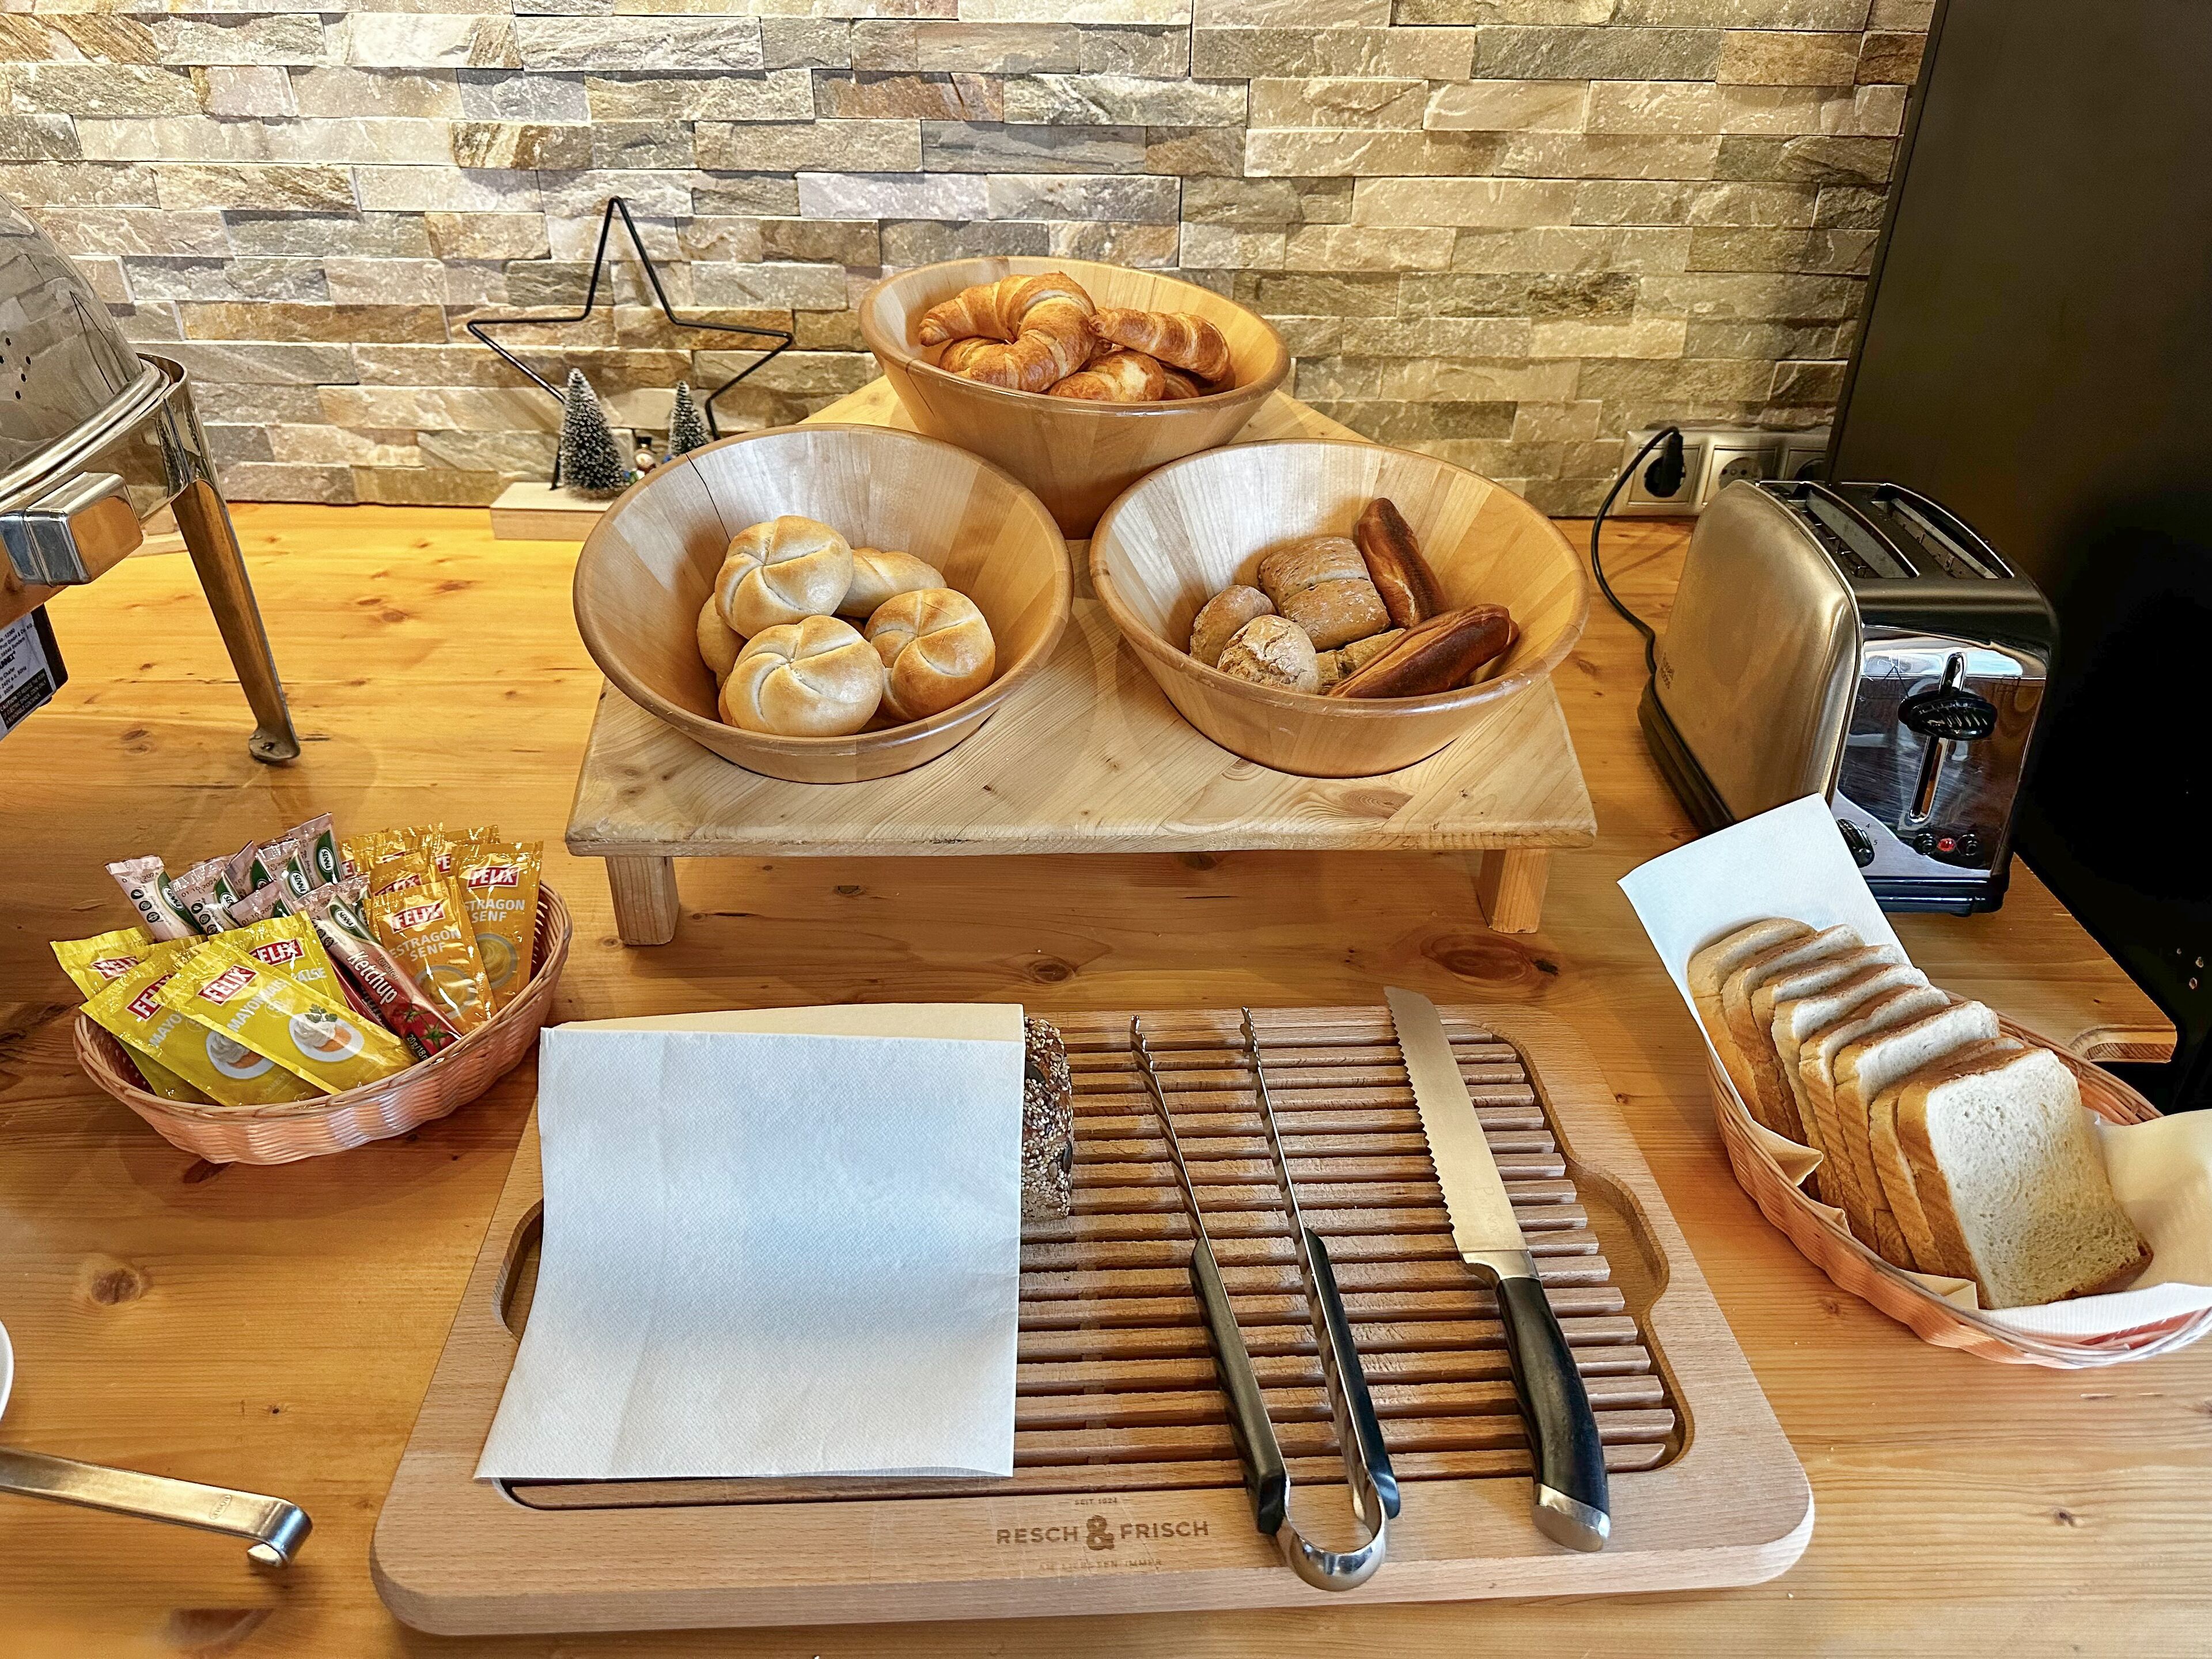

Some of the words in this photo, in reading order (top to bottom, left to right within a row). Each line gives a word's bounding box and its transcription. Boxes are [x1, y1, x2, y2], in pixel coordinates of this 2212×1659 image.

[322, 850, 331, 869] SENNA
[293, 873, 306, 892] SENNA
[471, 868, 513, 885] FELIX
[338, 912, 354, 926] SENNA
[395, 902, 441, 929] FELIX
[471, 911, 507, 923] SENF
[389, 930, 461, 959] ESTRAGON
[410, 942, 446, 962] SENF
[347, 950, 397, 1005] Ketchup
[376, 955, 400, 981] Tomaten
[203, 967, 252, 1001] FELIX
[997, 1527, 1078, 1544] RESCH
[1086, 1515, 1115, 1551] &
[1120, 1521, 1209, 1539] FRISCH
